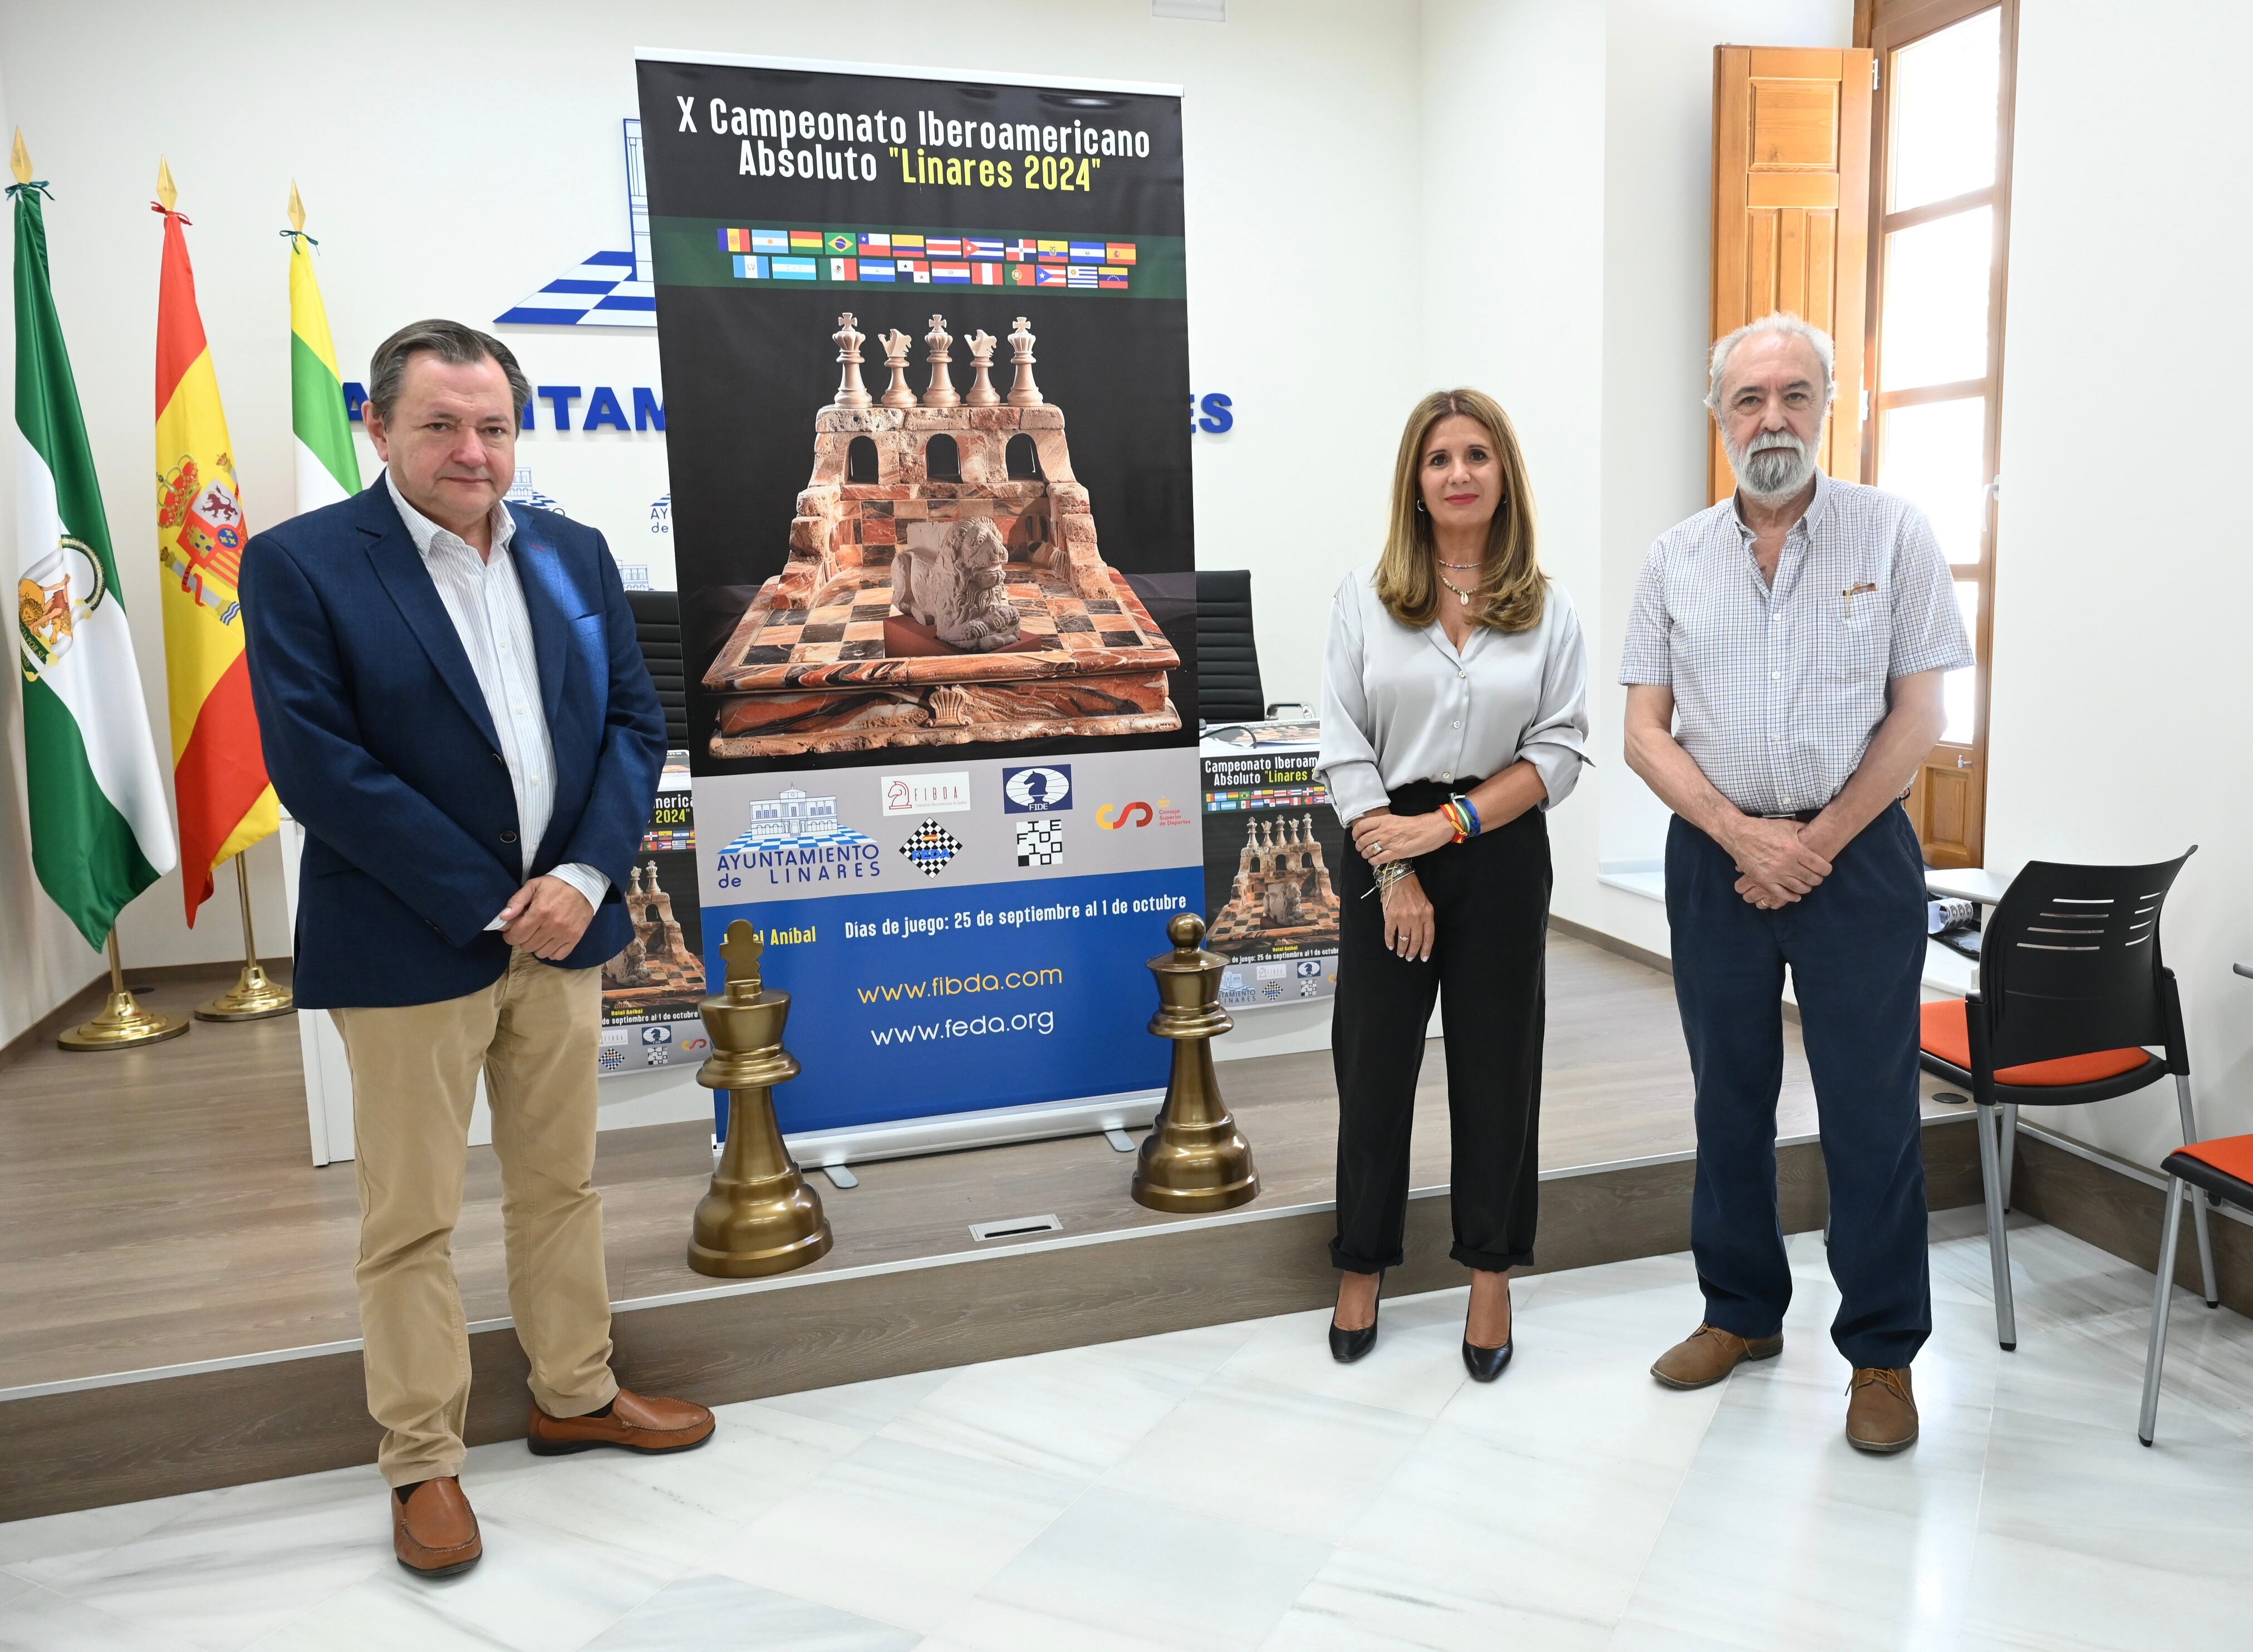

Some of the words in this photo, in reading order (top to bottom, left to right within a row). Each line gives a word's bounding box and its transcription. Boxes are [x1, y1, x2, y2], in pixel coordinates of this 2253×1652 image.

[676, 96, 698, 133] X
[710, 98, 906, 149] Campeonato
[918, 110, 1150, 158] Iberoamericano
[739, 140, 877, 181] Absoluto
[889, 146, 1013, 188] "Linares
[1024, 154, 1101, 192] 2024"
[651, 522, 669, 533] de
[1205, 759, 1271, 775] Campeonato
[1275, 756, 1317, 769] Iberoam
[1214, 771, 1260, 786] Absoluto
[1264, 770, 1307, 783] "Linares
[914, 786, 958, 802] FIBDA
[656, 809, 690, 823] 2024"
[717, 844, 879, 871] AYUNTAMIENTO
[912, 848, 950, 861] FEDA
[718, 873, 742, 888] de
[770, 861, 880, 884] LINARES
[845, 921, 876, 938] Días
[882, 918, 899, 936] de
[901, 917, 949, 938] juego:
[954, 911, 971, 929] 25
[976, 910, 994, 927] de
[999, 903, 1080, 928] septiembre
[1085, 901, 1097, 917] al
[1102, 899, 1107, 916] 1
[1112, 898, 1128, 914] de
[1133, 894, 1187, 912] octubre
[770, 926, 817, 946] Aníbal
[1239, 955, 1256, 964] juego:
[1273, 951, 1303, 960] septiembre
[857, 968, 1062, 1004] www.fibda.com
[612, 1015, 649, 1026] septiembre
[663, 1012, 671, 1020] de
[673, 1010, 698, 1020] octubre
[871, 1011, 1053, 1046] www.feda.org
